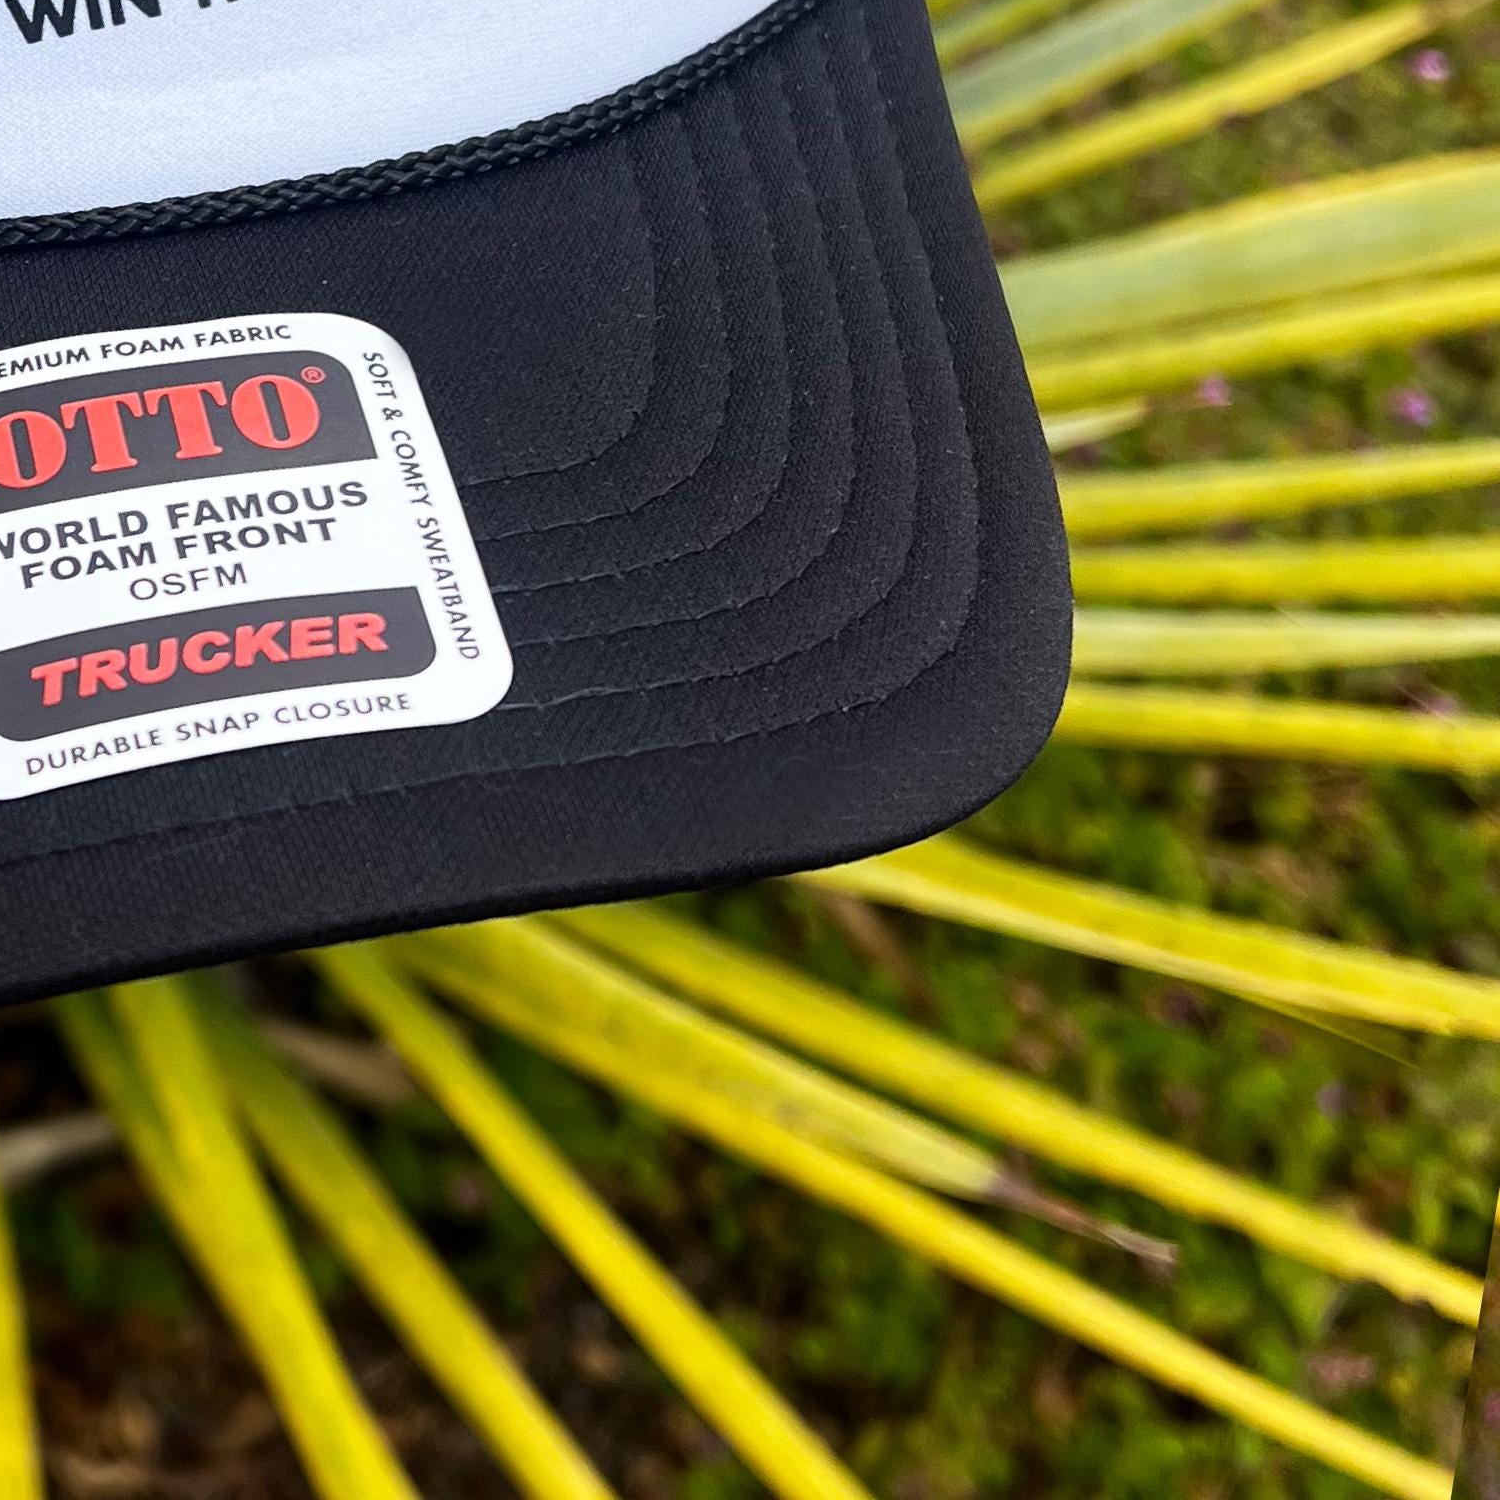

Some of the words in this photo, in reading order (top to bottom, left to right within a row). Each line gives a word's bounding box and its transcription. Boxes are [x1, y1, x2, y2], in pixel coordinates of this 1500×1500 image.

[100, 336, 185, 359] FOAM
[194, 325, 291, 348] FABRIC
[363, 352, 397, 399] SOFT
[381, 406, 404, 422] &
[391, 430, 432, 506] COMFY
[166, 481, 368, 530] FAMOUS
[20, 541, 157, 589] FOAM
[173, 517, 336, 560] FRONT
[129, 562, 247, 601] OSFM
[417, 517, 480, 659] SWEATBAND
[30, 611, 388, 707] TRUCKER
[26, 729, 161, 776] DURABLE
[176, 712, 259, 741] SNAP
[274, 693, 411, 725] CLOSURE
